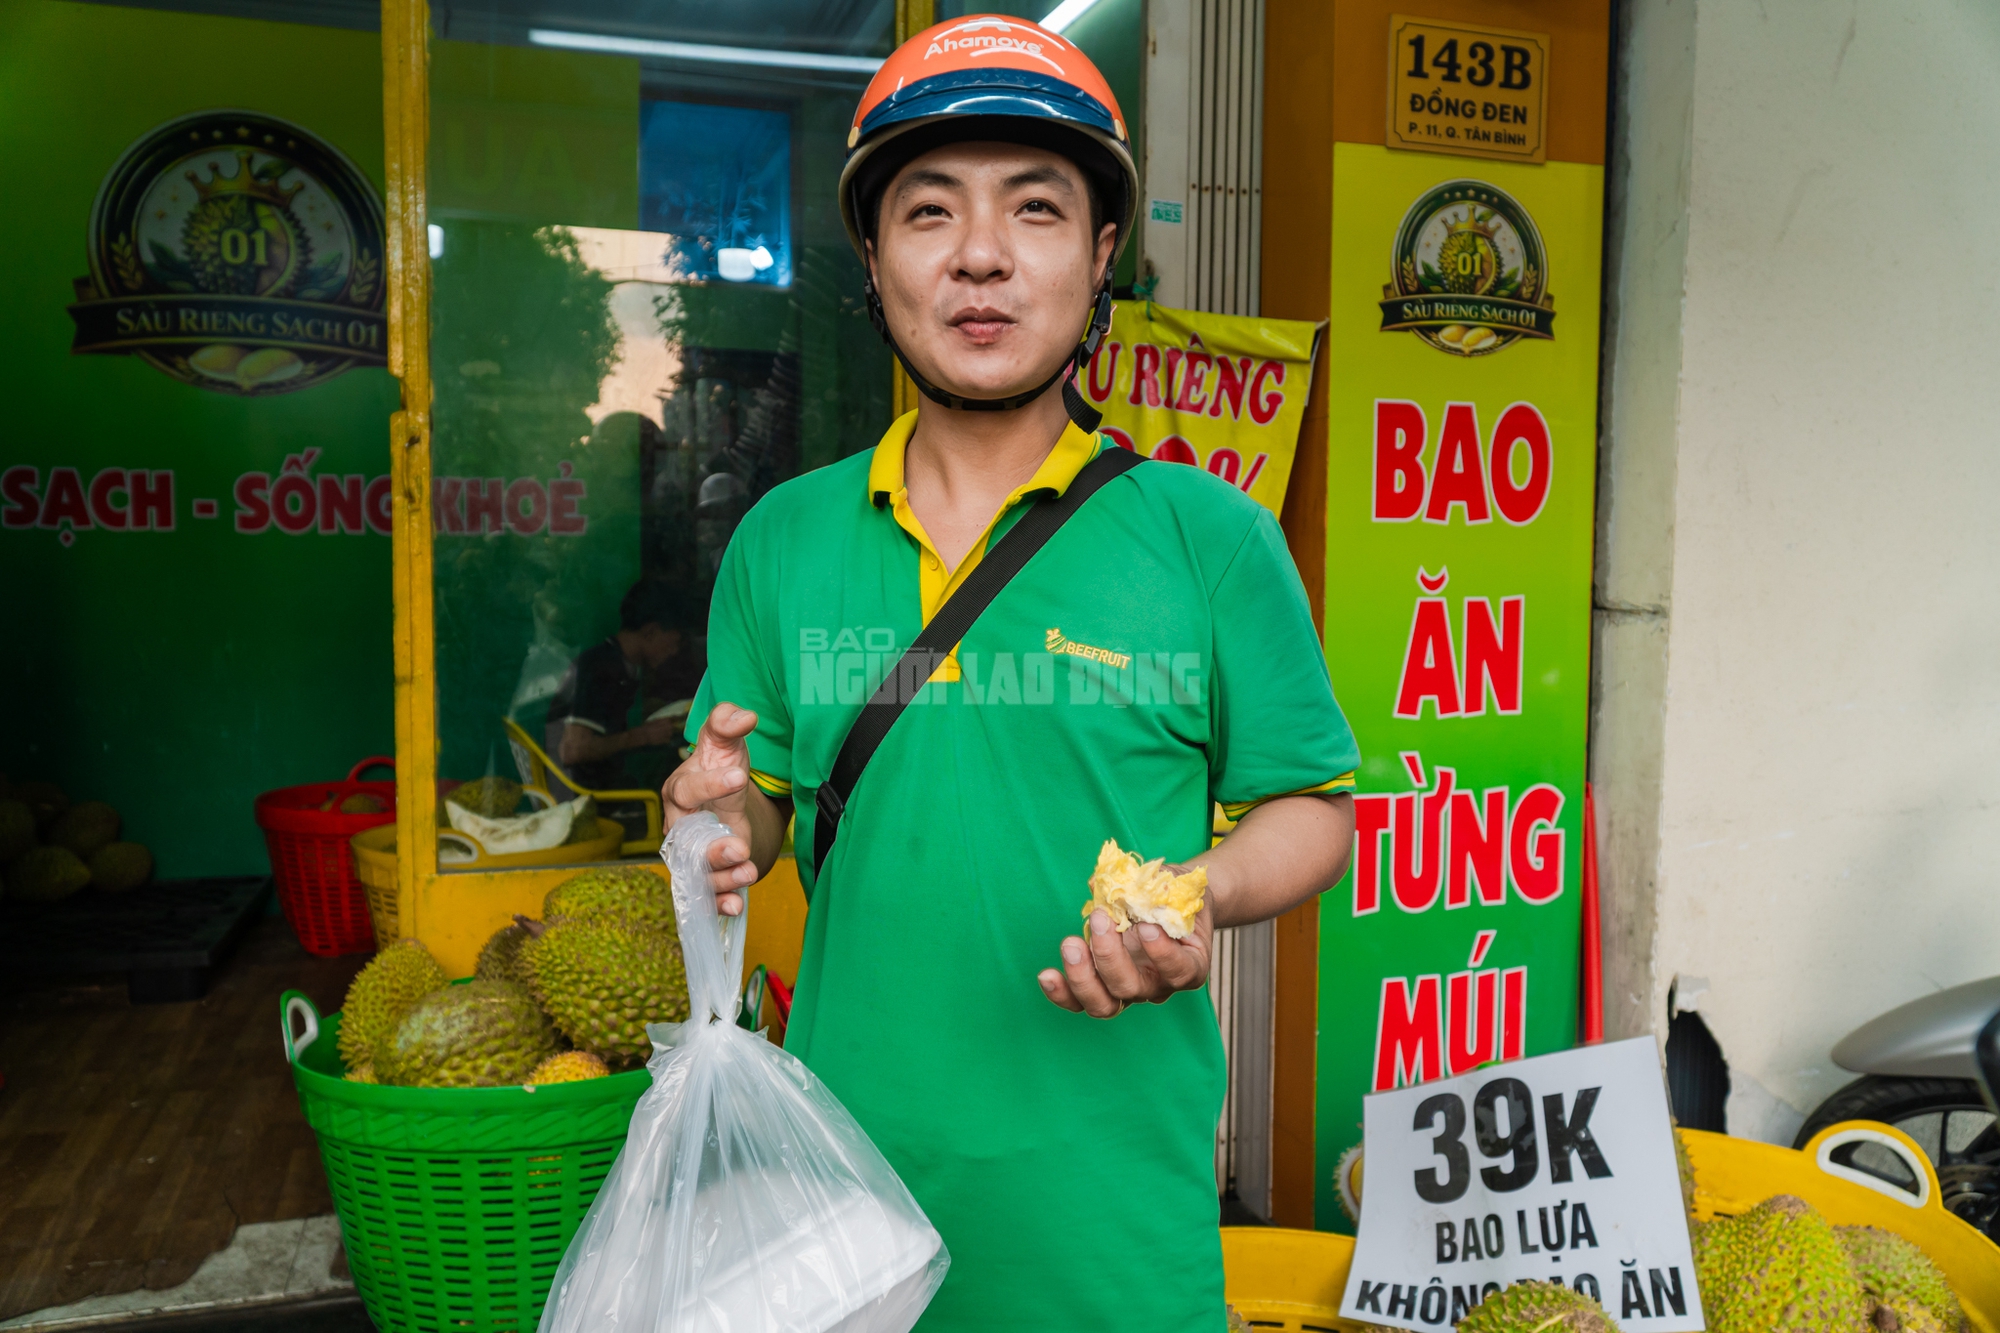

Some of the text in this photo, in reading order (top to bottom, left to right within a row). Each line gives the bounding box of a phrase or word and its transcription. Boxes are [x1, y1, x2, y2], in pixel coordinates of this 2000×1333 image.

[923, 36, 1043, 60] Ahamove
[1406, 34, 1532, 90] 143B
[1408, 122, 1422, 134] P.
[1445, 126, 1460, 139] Q.
[1464, 126, 1491, 142] TÂN
[1493, 129, 1526, 145] BÌNH
[1409, 86, 1527, 125] ĐỒNG ĐEN
[220, 228, 268, 266] 01
[1457, 252, 1482, 276] 01
[346, 320, 379, 349] 01
[1519, 309, 1536, 328] 01
[1128, 330, 1286, 426] RIÊNG
[1371, 398, 1553, 526] BAO
[1, 465, 175, 547] SẠCH
[1065, 640, 1131, 670] BEEFRUIT
[1393, 566, 1526, 721] ĂN
[1353, 752, 1566, 917] TỪNG
[1372, 931, 1528, 1094] MÚI
[1412, 1077, 1614, 1204] 39K
[1435, 1199, 1599, 1265] BAO LỰA
[1619, 1258, 1688, 1320] ĂN
